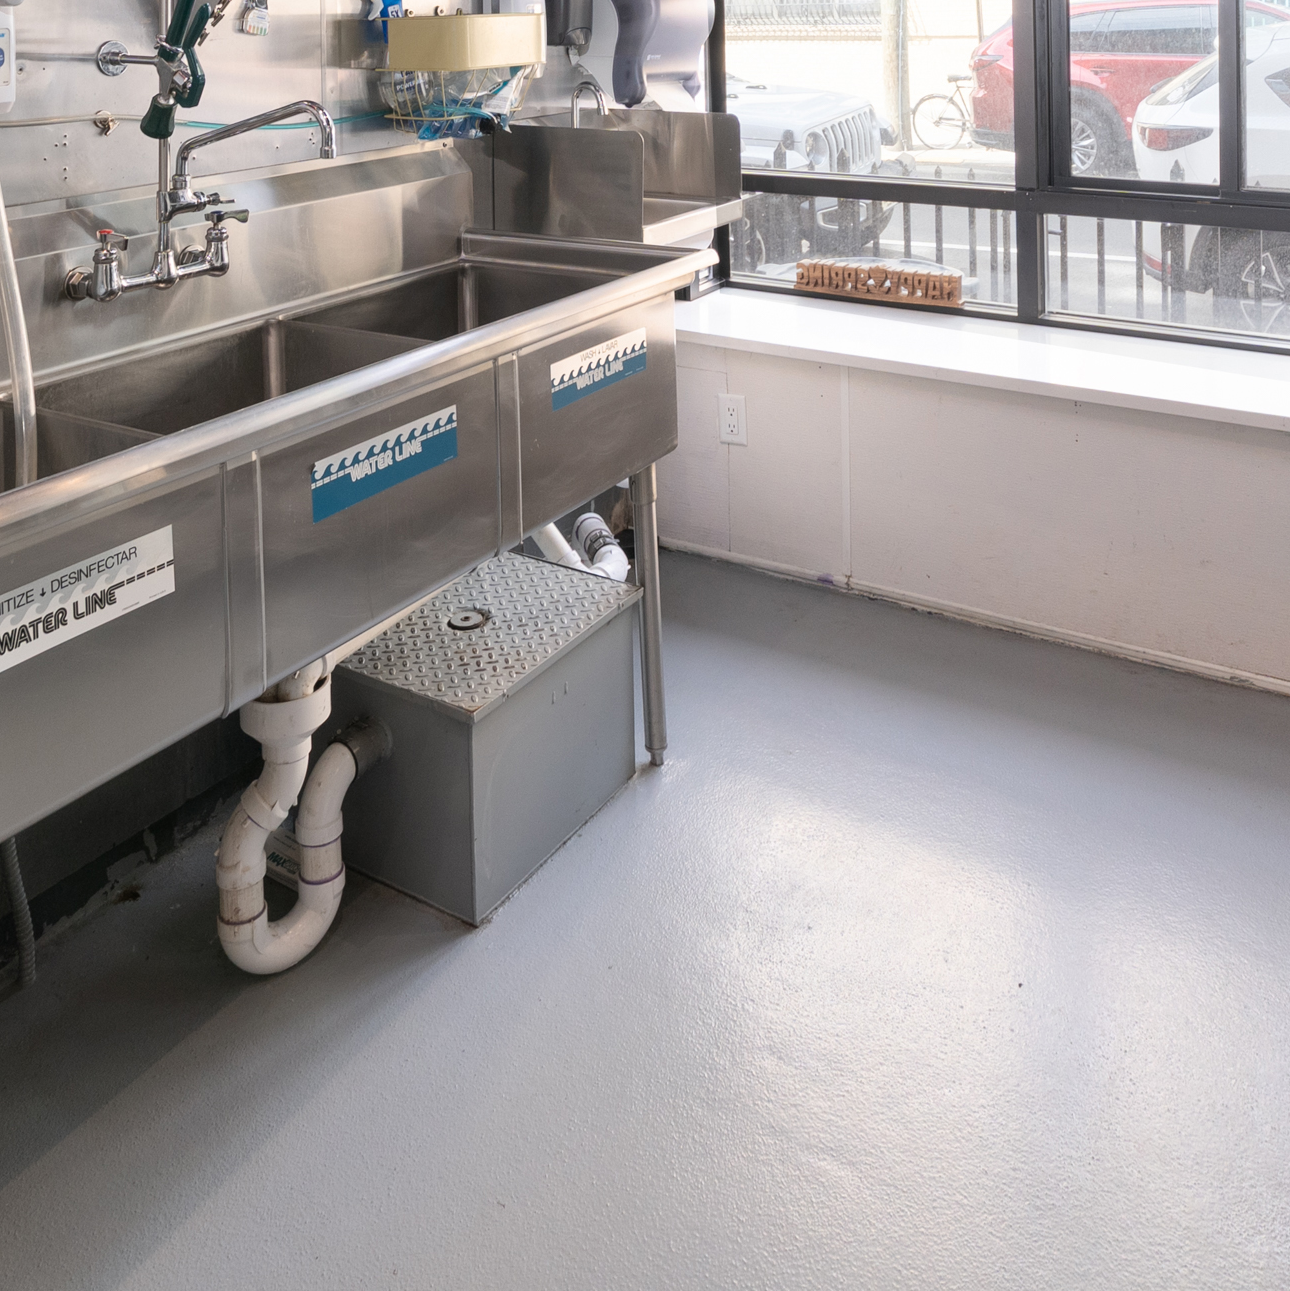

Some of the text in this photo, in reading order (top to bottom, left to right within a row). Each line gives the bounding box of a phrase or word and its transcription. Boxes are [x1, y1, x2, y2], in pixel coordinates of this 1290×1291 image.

[579, 339, 619, 362] WASH LAVAR
[575, 358, 624, 390] WATER LINE
[348, 437, 425, 483] WATER LINE
[50, 546, 138, 594] DESINFECTAR
[72, 581, 121, 621] LINE
